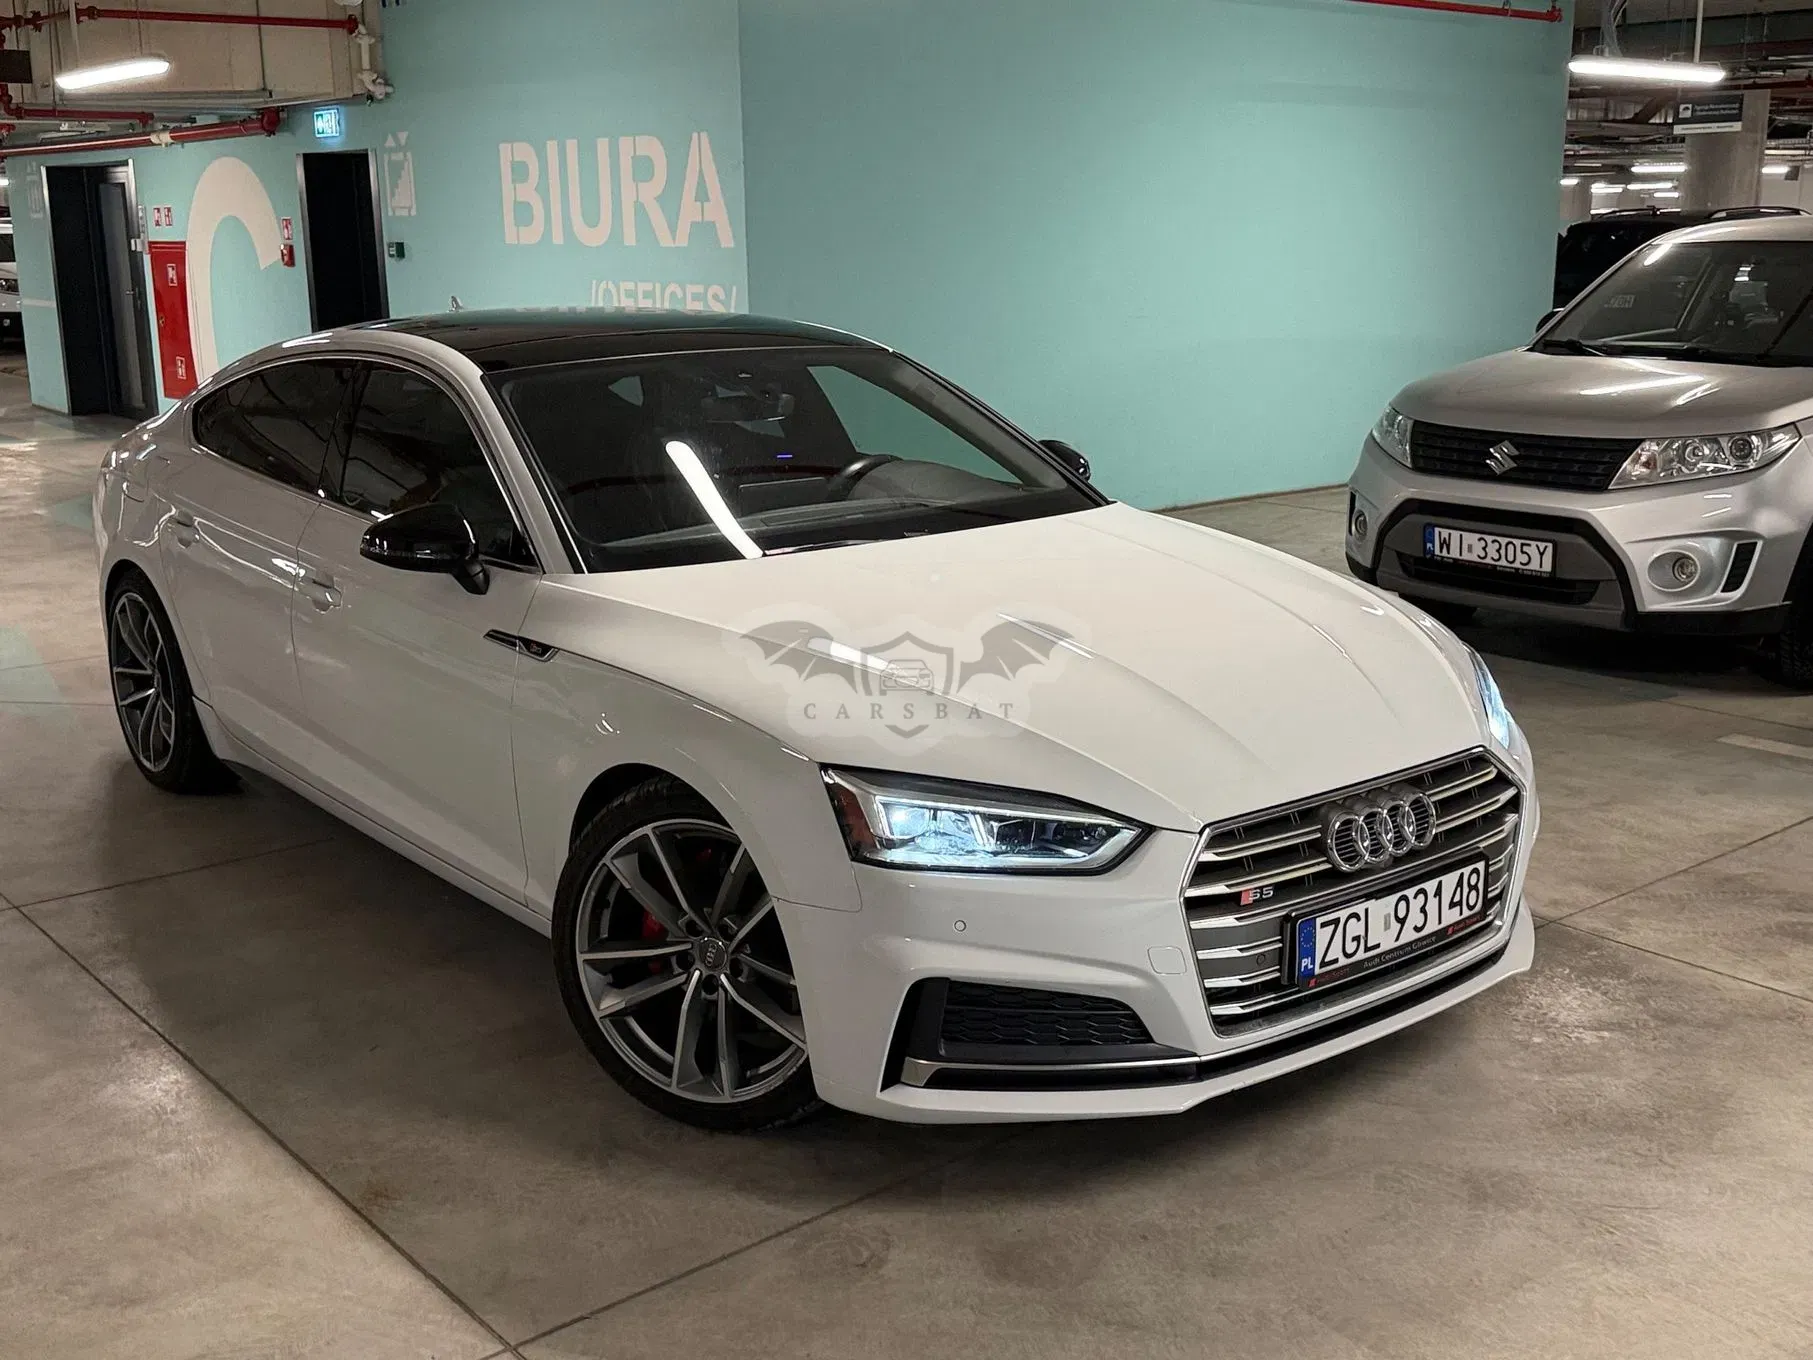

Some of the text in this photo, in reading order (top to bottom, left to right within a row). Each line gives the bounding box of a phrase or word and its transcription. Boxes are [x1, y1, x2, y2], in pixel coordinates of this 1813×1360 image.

[499, 131, 735, 248] BIURA
[1438, 531, 1548, 569] WI 3305Y
[1249, 886, 1274, 900] S5
[1319, 867, 1481, 970] ZGL 93148
[1301, 957, 1314, 972] PL
